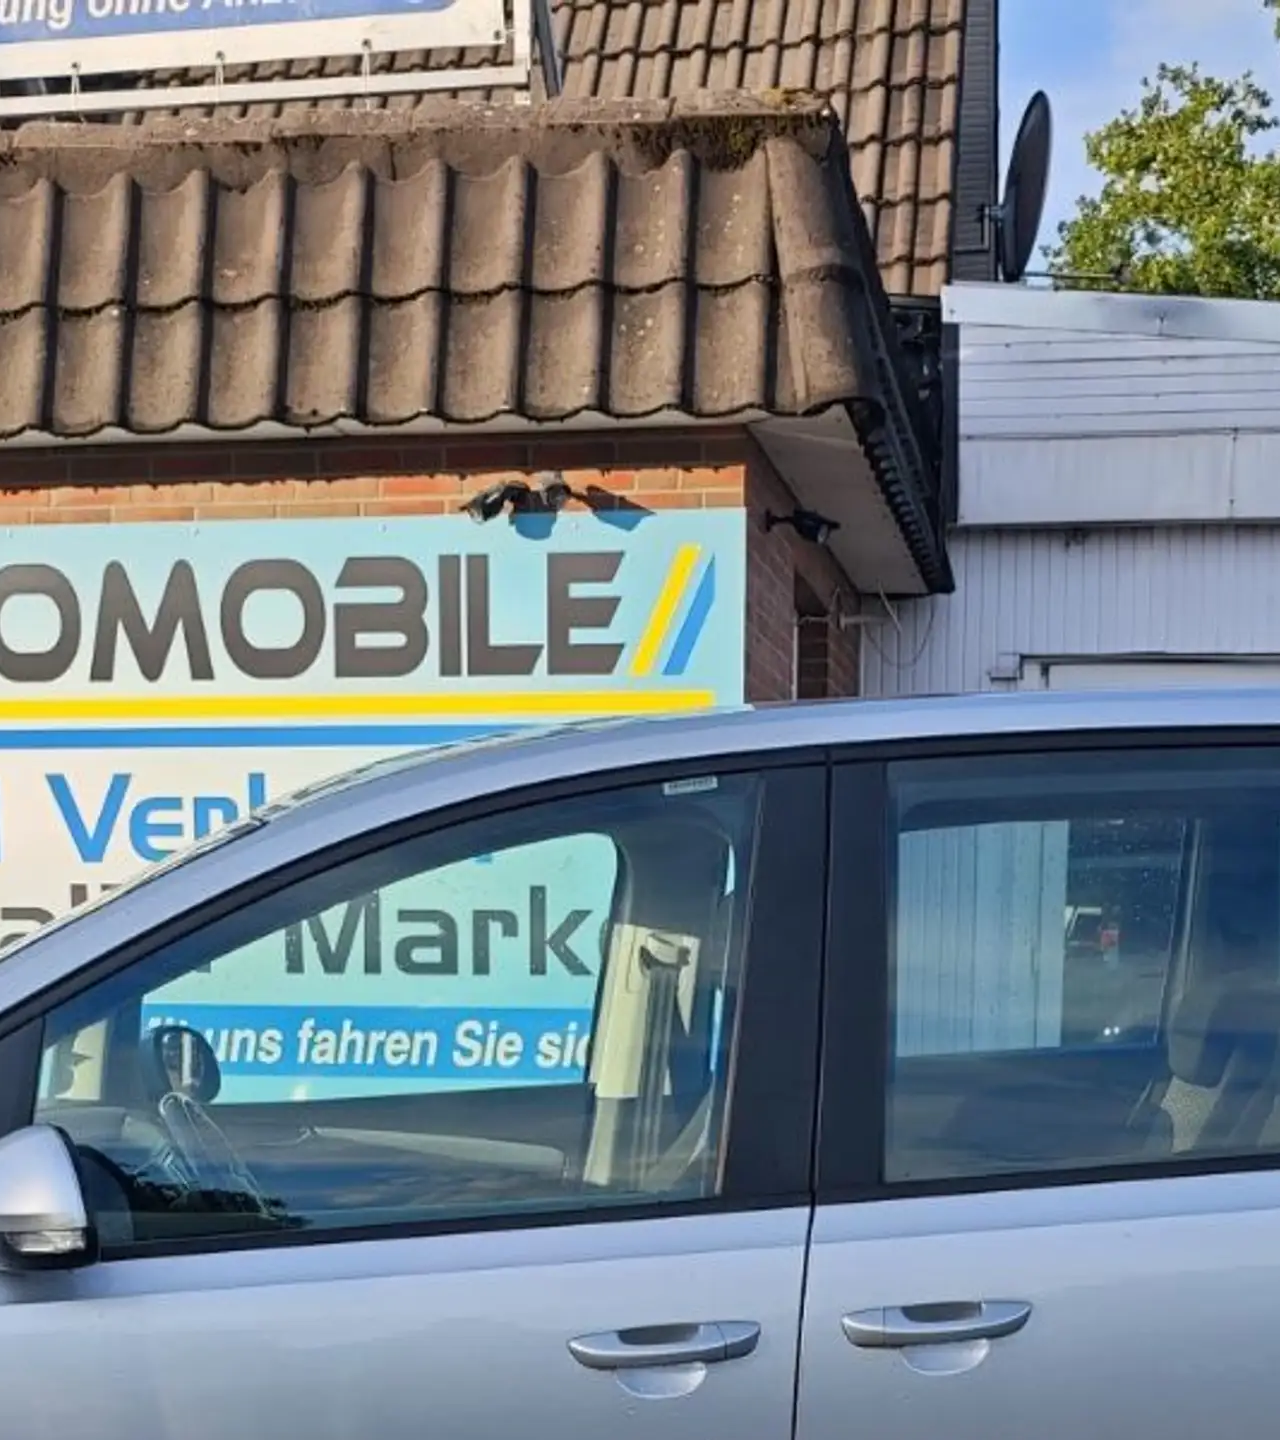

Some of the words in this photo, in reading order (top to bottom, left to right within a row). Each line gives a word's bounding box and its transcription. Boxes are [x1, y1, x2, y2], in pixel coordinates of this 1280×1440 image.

[284, 884, 609, 976] Mark
[204, 1025, 283, 1067] uns
[296, 1016, 439, 1067] fahren
[452, 1018, 524, 1068] Sie
